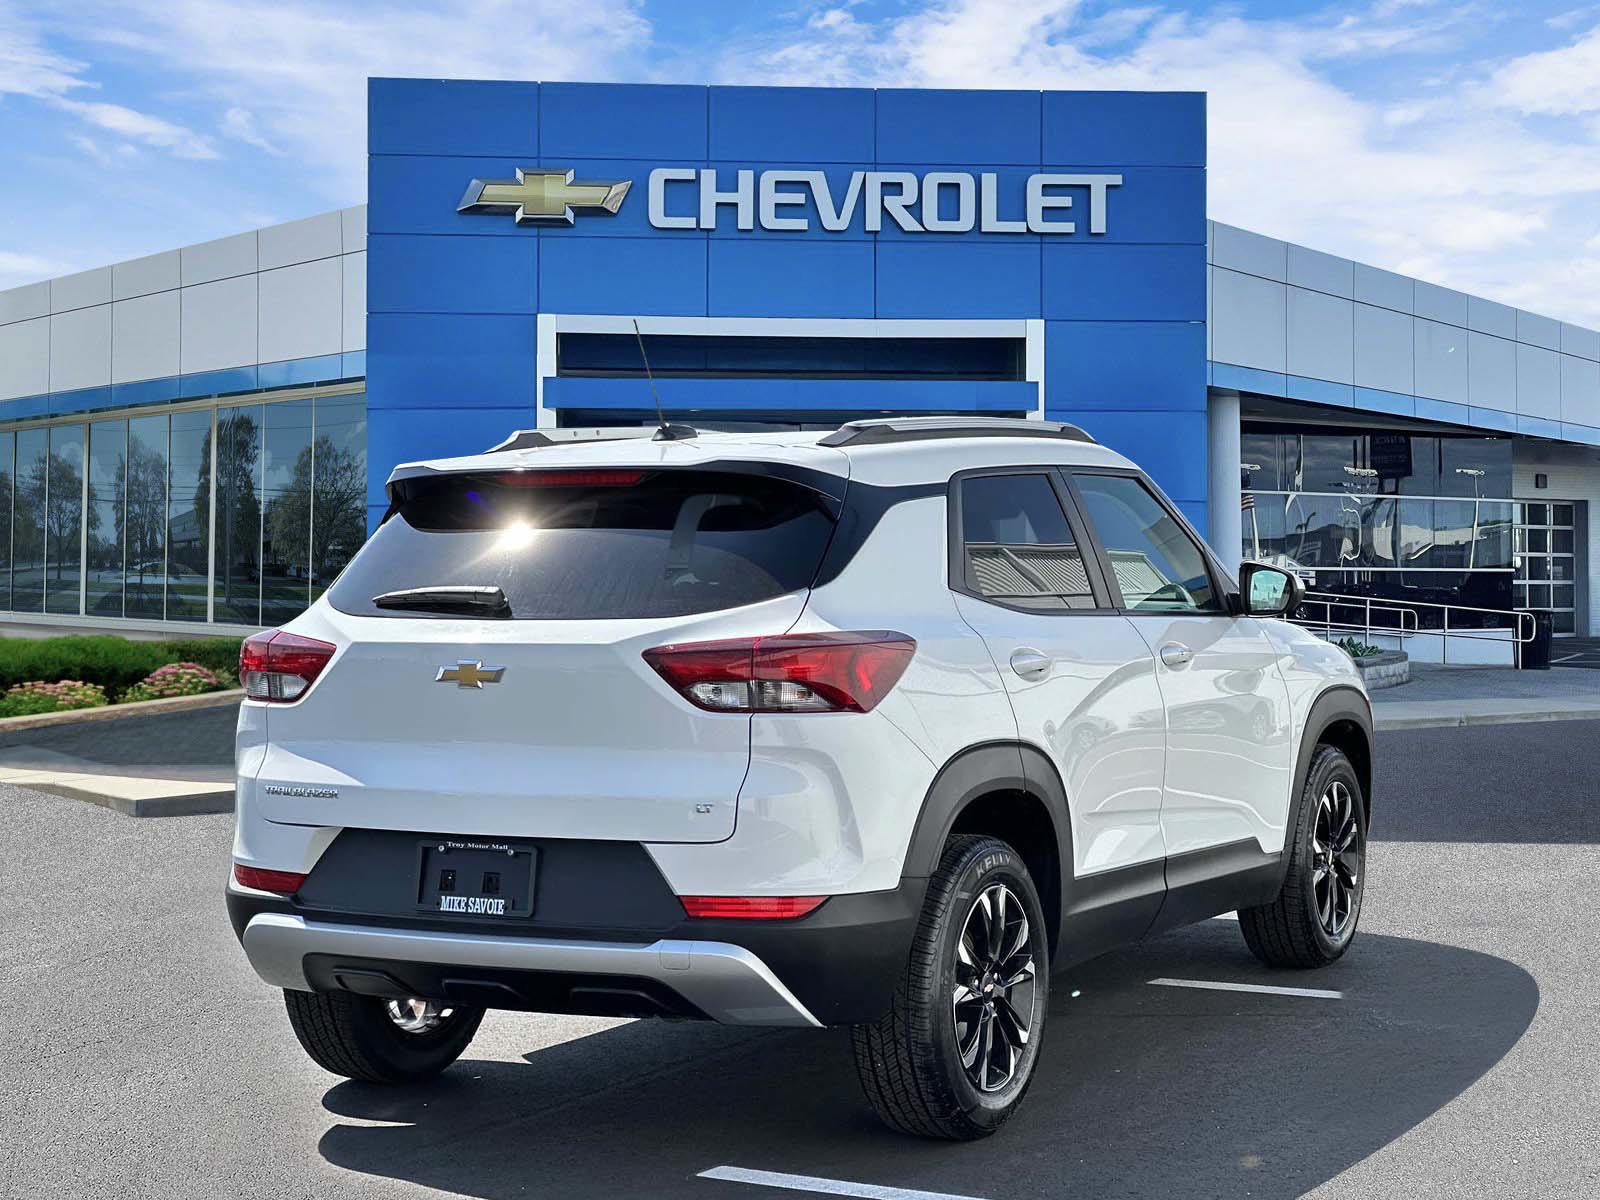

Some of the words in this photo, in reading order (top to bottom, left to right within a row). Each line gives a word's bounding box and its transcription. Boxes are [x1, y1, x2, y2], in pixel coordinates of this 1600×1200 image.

[648, 167, 1123, 235] CHEVROLET
[265, 785, 339, 799] TRAILBLAZER
[696, 803, 713, 814] LT
[976, 853, 1010, 879] KELLY
[440, 896, 467, 912] MIKE
[468, 897, 504, 915] SAVOIE
